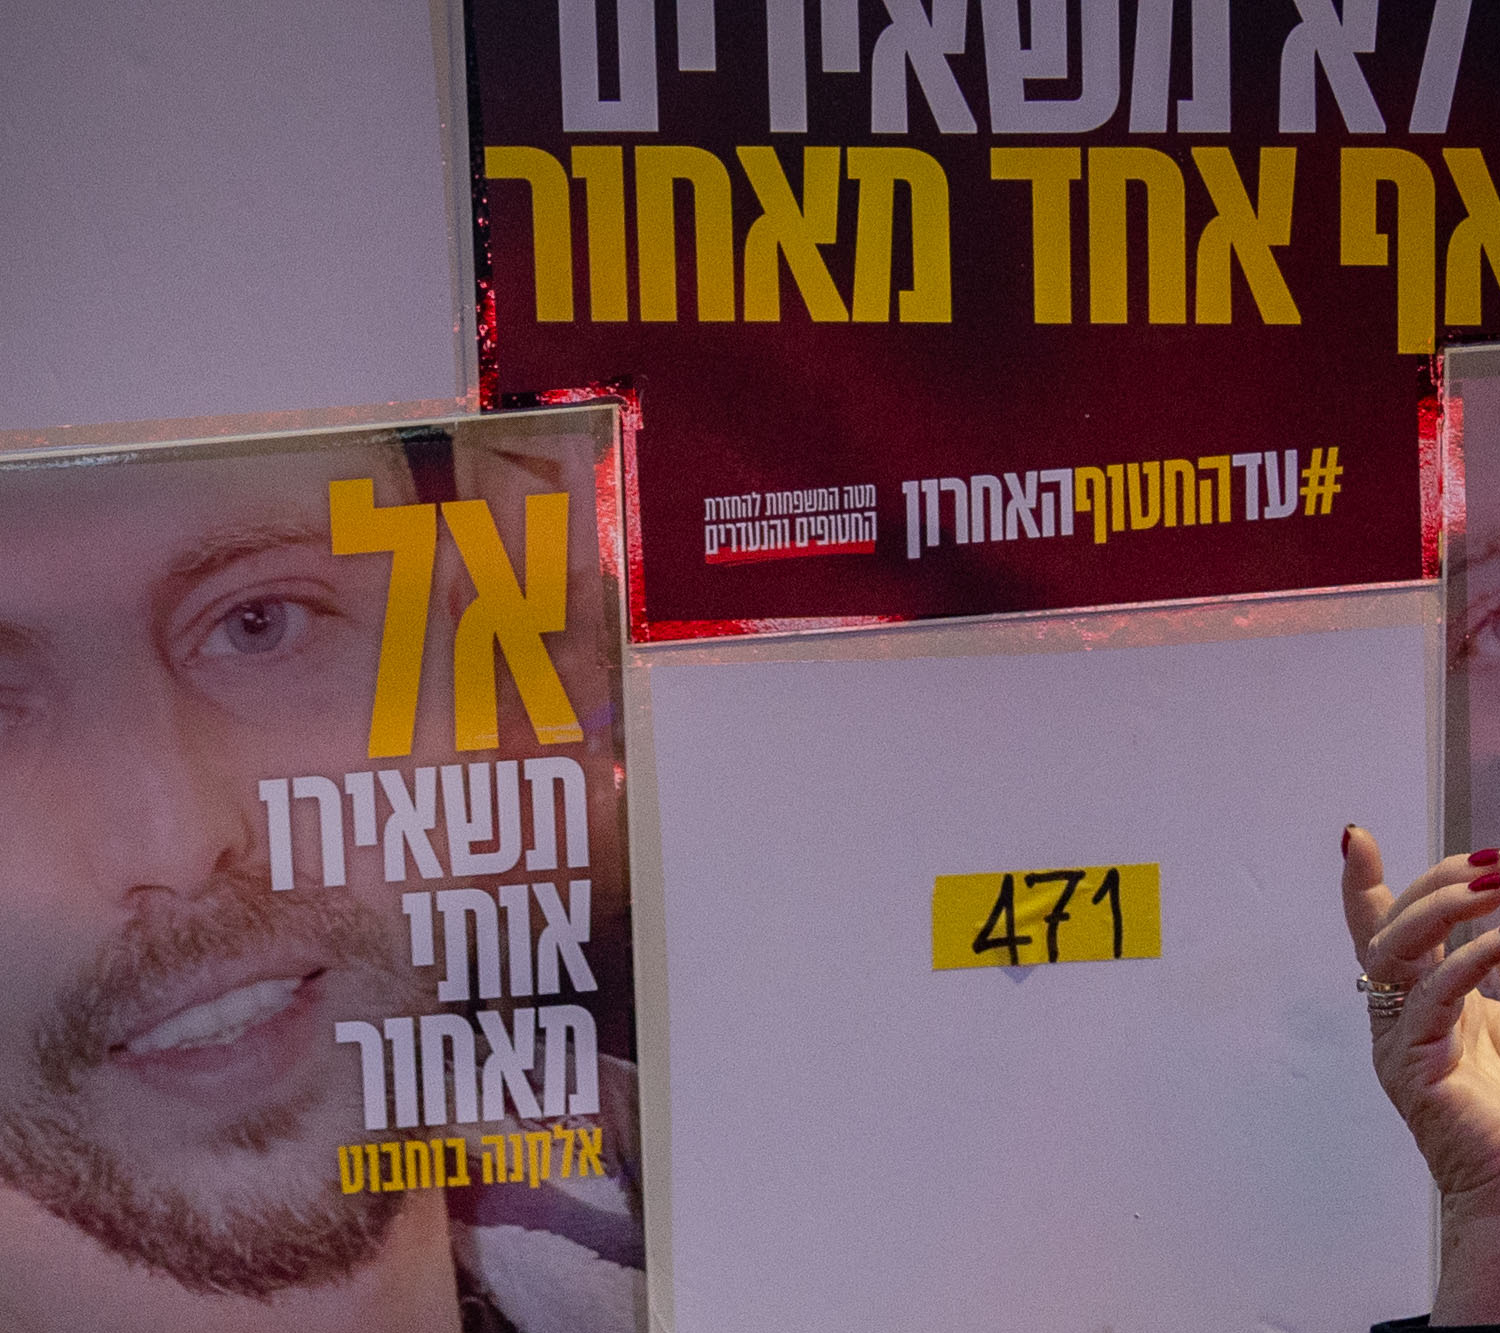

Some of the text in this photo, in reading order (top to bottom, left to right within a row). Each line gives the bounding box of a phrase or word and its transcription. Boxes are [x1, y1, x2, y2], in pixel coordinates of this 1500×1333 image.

[484, 145, 953, 324] מאחור
[990, 146, 1302, 326] אחד
[703, 483, 878, 522] מטה המשפחות להחזרת
[704, 511, 878, 556] החטופים והנעדרים
[328, 478, 584, 759] אל
[258, 755, 590, 892] תשאירו
[402, 879, 598, 1003] אותי
[971, 867, 1124, 967] 471
[334, 1003, 601, 1131] מאחור
[337, 1123, 606, 1195] אלקנה בוחבוט
